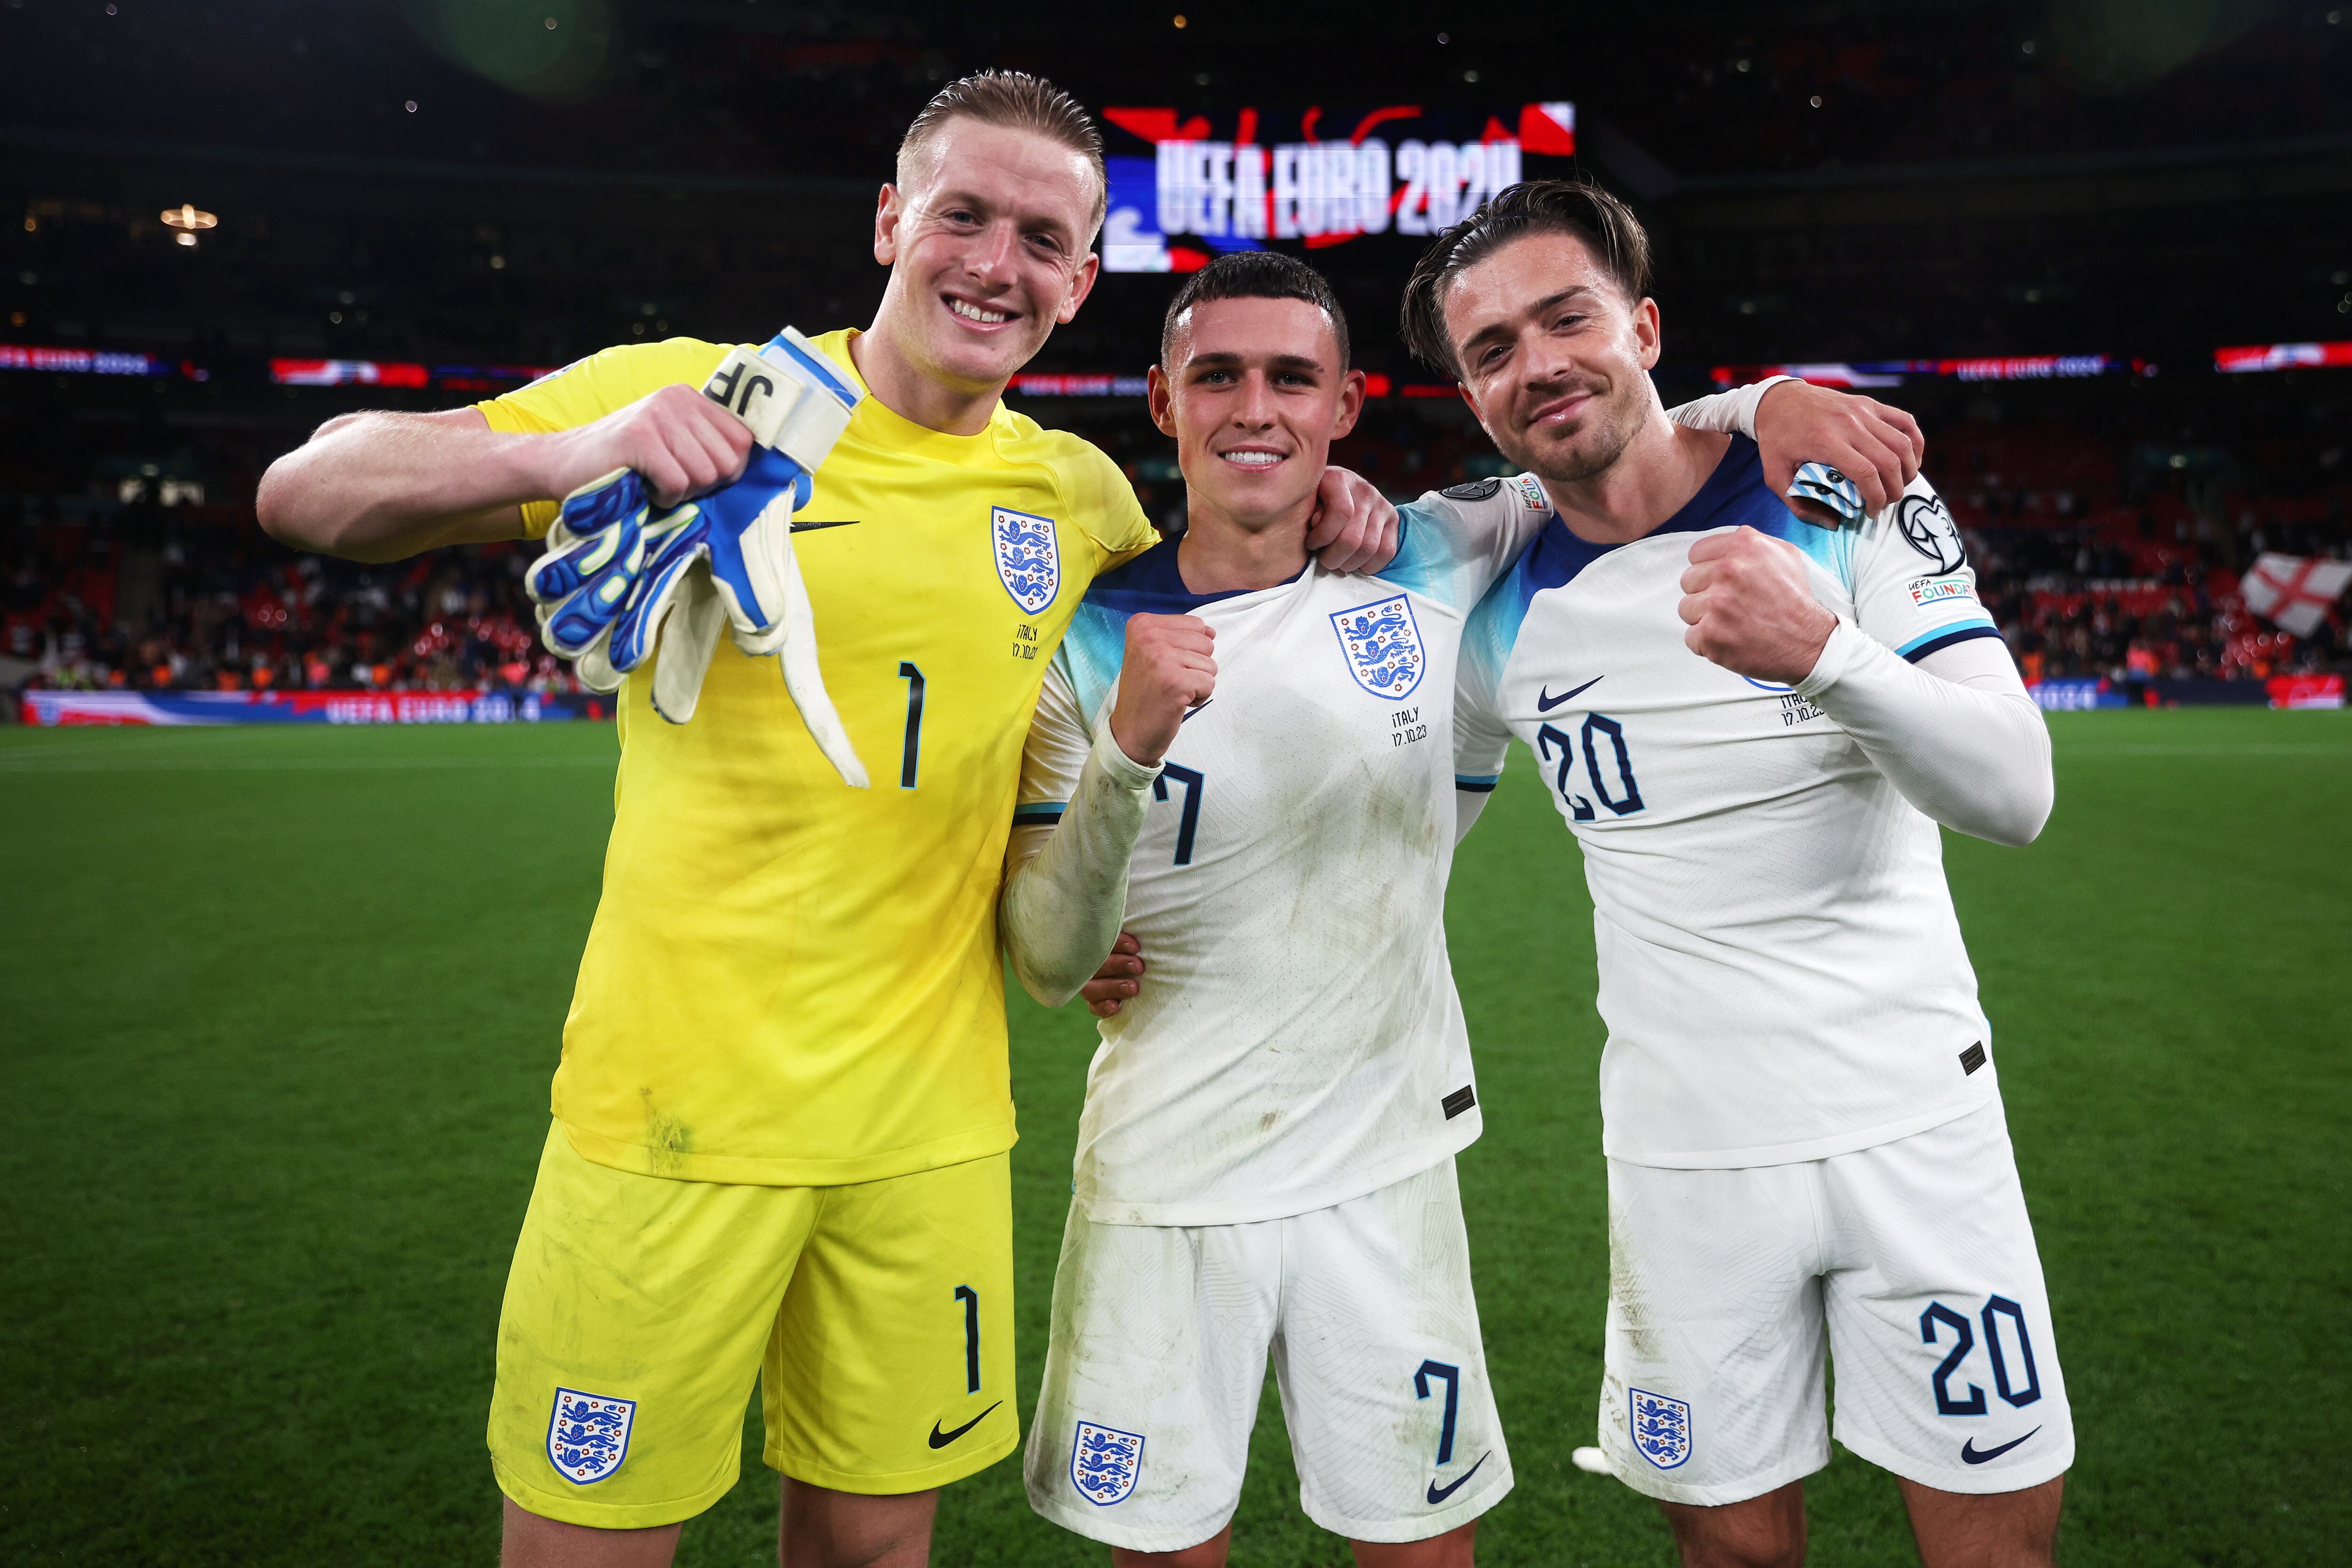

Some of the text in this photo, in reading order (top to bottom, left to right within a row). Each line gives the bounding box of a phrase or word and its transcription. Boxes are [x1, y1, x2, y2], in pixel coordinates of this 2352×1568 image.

[1156, 138, 1267, 239] UEFA
[1272, 138, 1391, 238] EURO
[1908, 579, 1932, 591] UEFA
[326, 697, 394, 725] UEFA
[397, 696, 469, 724] EURO
[898, 661, 926, 790] 1
[1391, 724, 1427, 747] 17.10.23
[1153, 760, 1205, 866] 7
[1537, 711, 1646, 822] 20
[954, 1284, 981, 1395] 1
[1918, 1293, 2042, 1417] 20
[1413, 1358, 1460, 1467] 7
